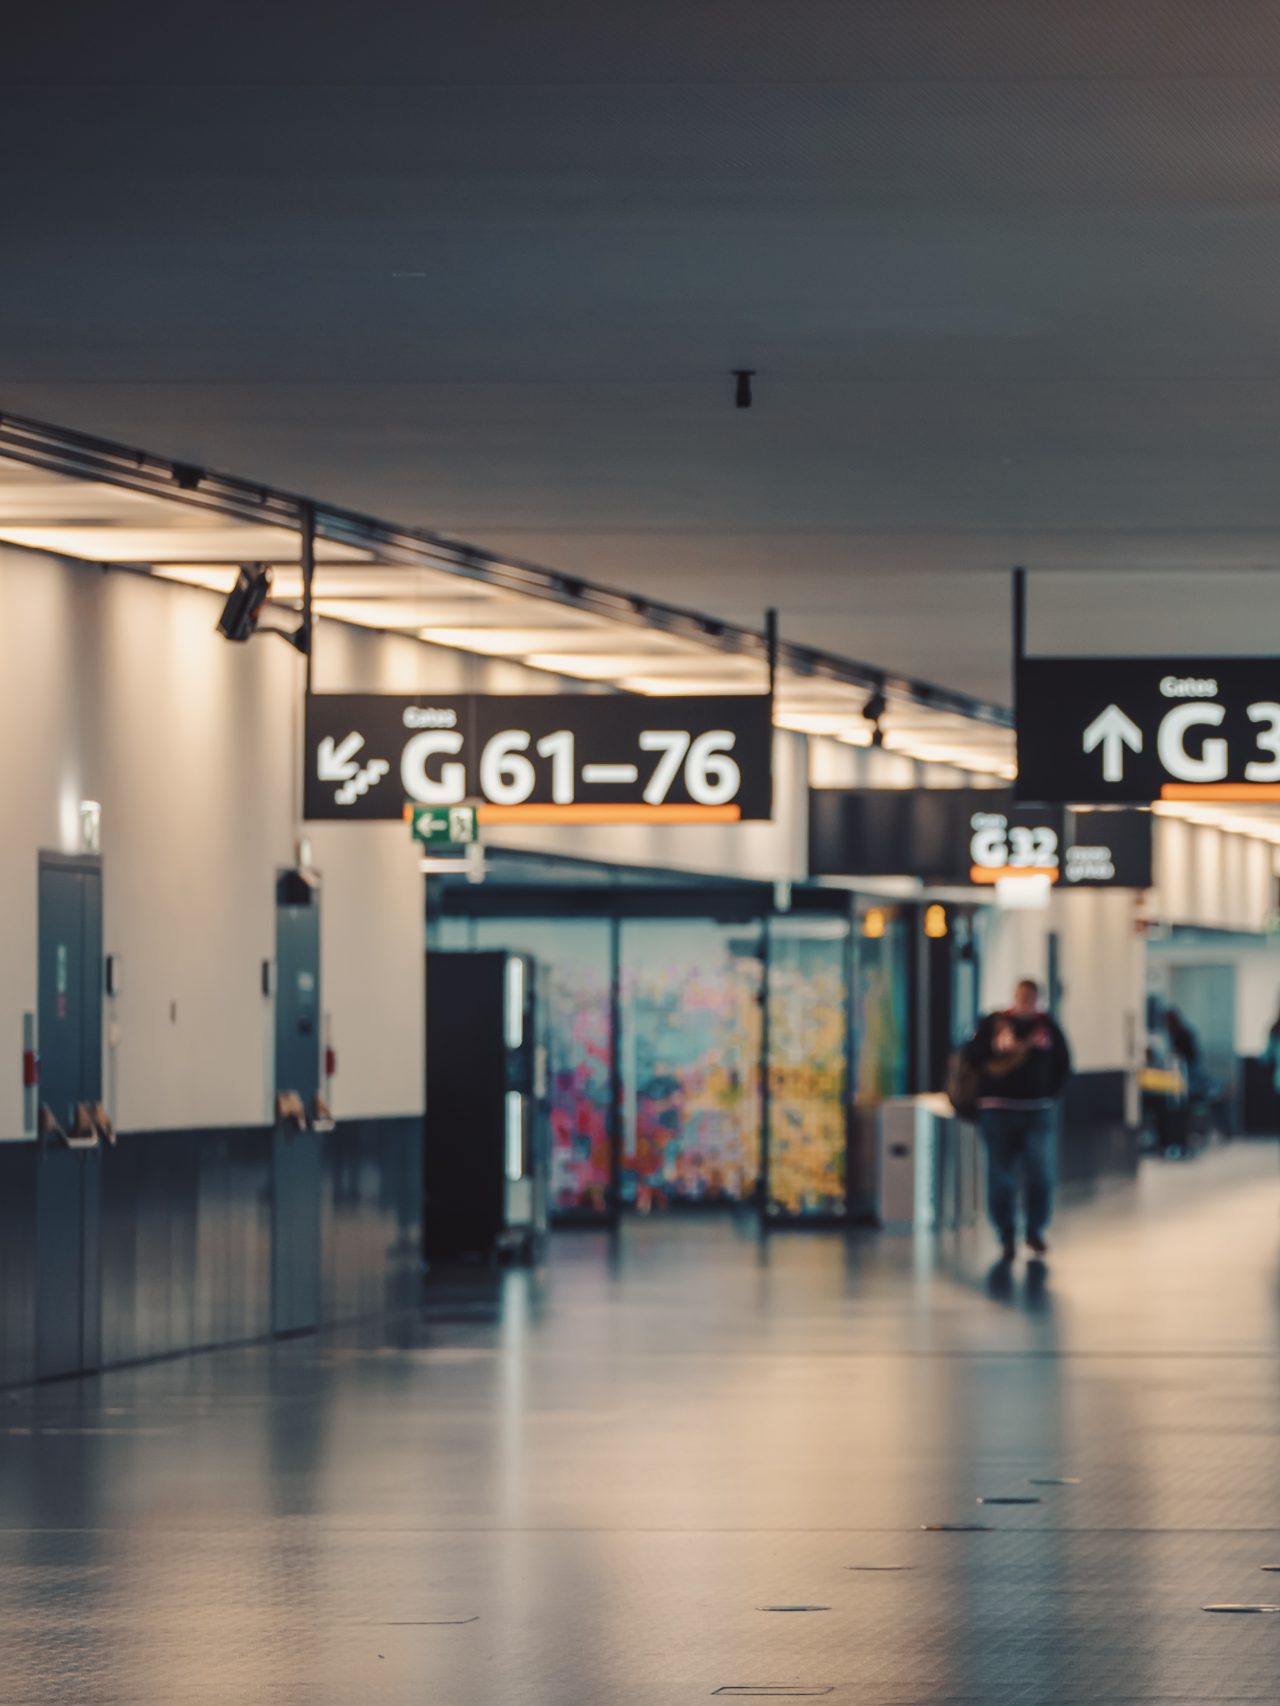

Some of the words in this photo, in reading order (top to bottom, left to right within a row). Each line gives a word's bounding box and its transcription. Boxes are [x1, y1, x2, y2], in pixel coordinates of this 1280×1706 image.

[1159, 676, 1218, 698] Gates
[400, 730, 466, 804] G
[1157, 702, 1228, 783] G
